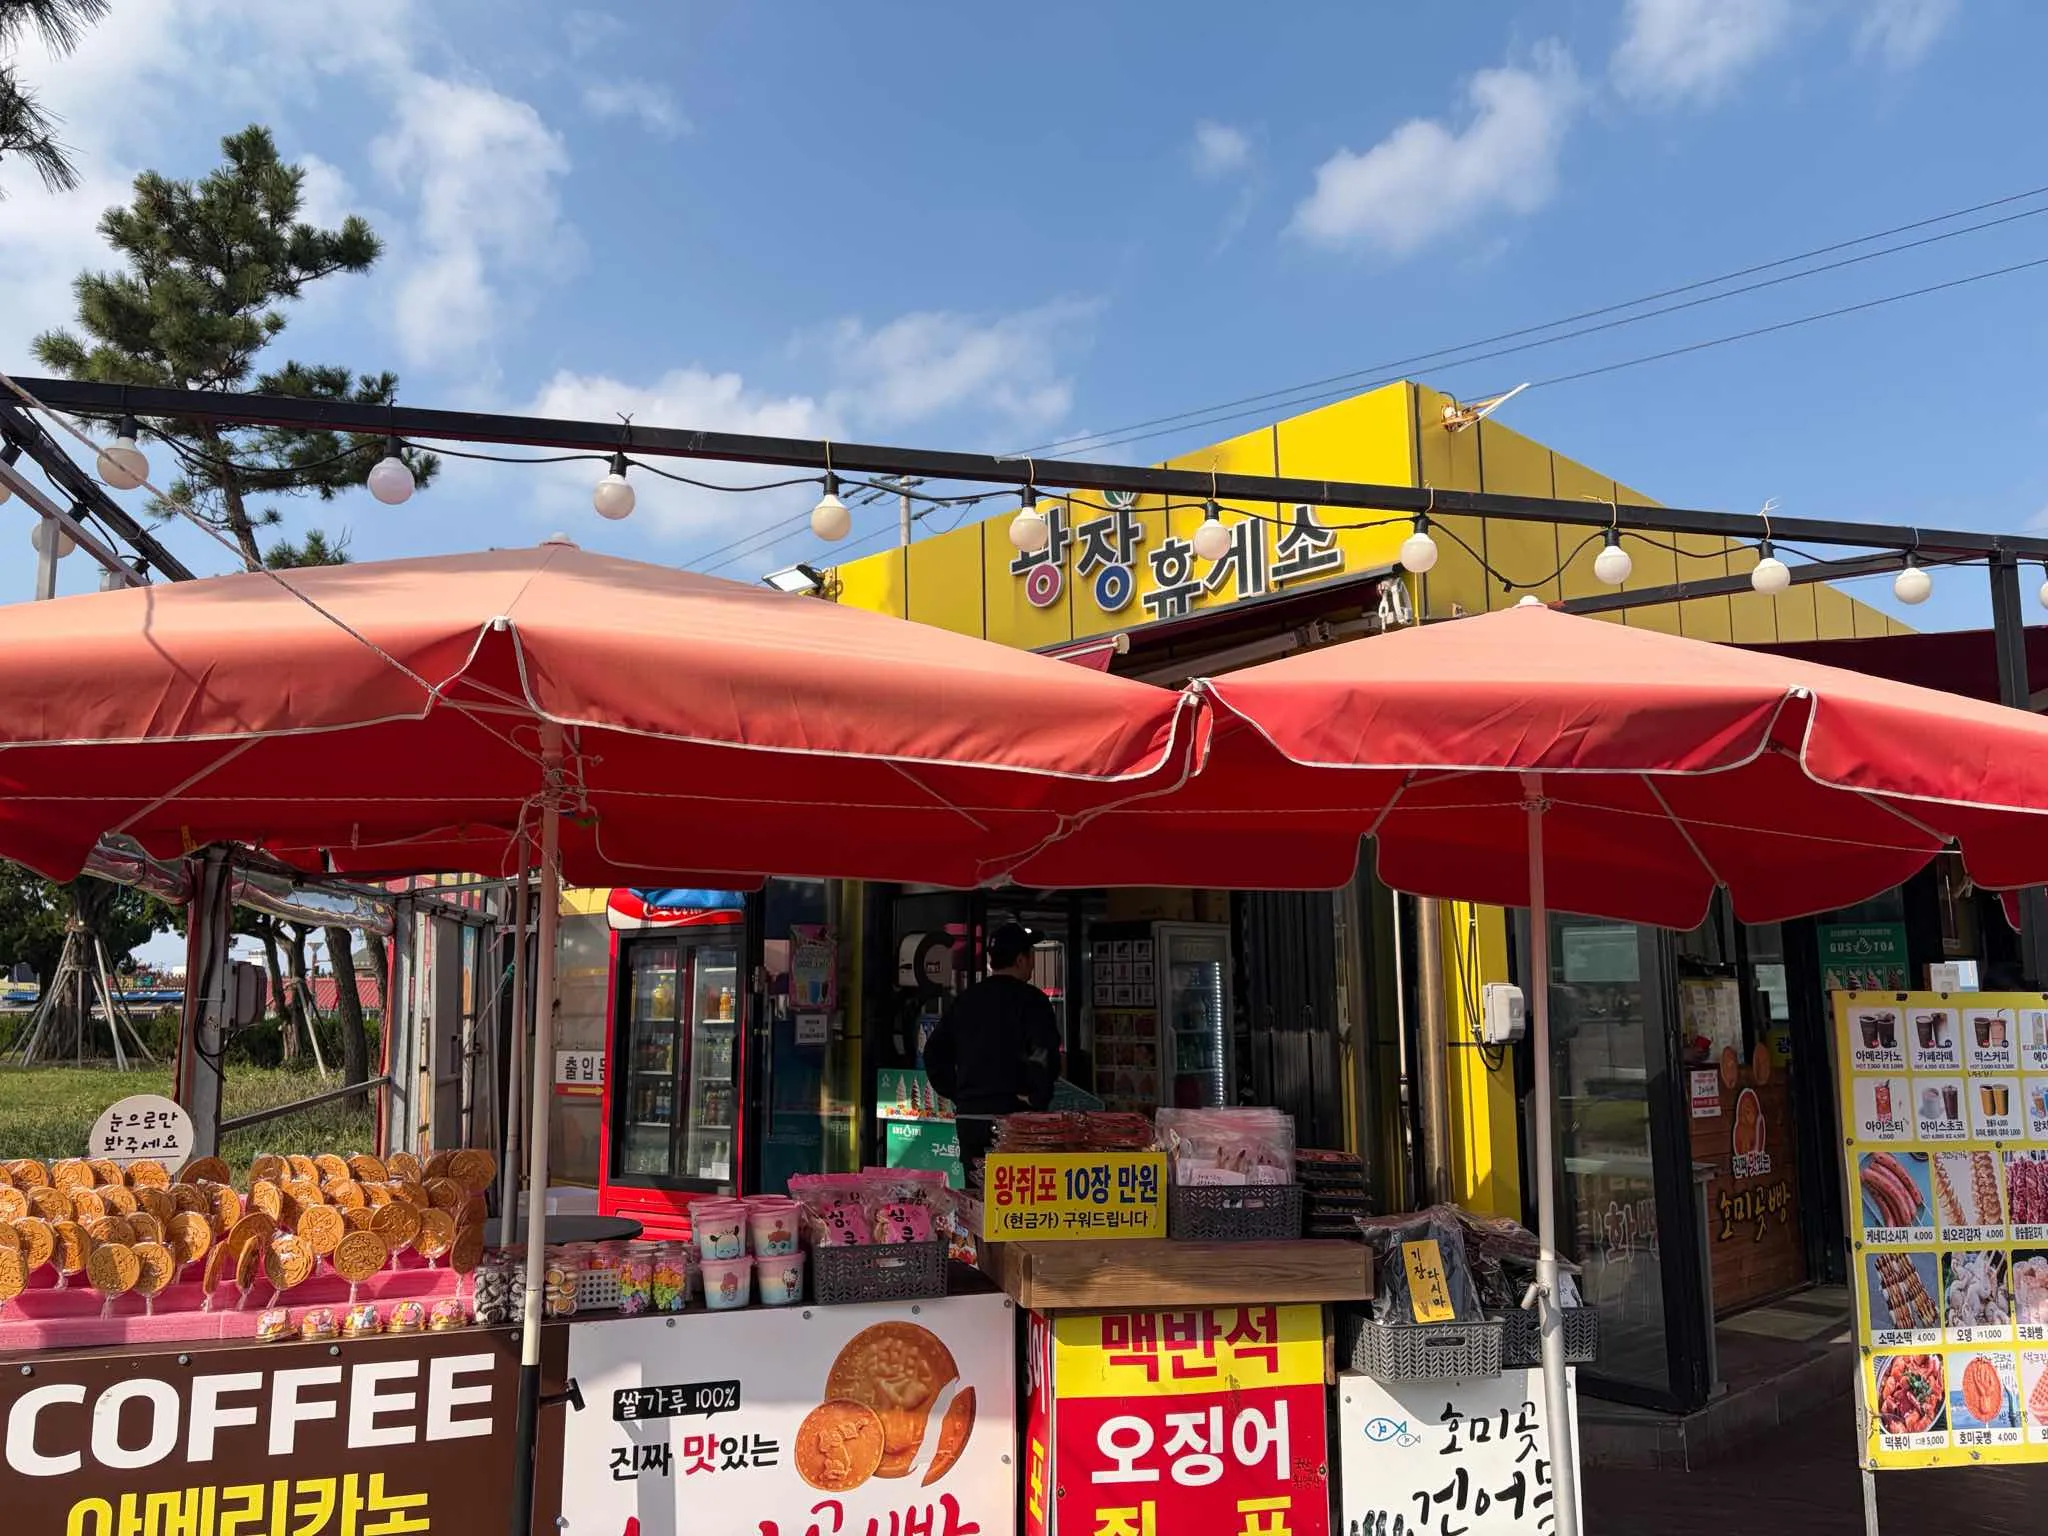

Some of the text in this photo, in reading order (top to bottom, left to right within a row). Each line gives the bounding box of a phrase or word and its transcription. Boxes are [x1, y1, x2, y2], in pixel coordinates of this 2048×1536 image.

[1856, 1050, 1903, 1062] 아메리카노
[1918, 1050, 1953, 1062] 카페라떼
[1975, 1050, 2009, 1062] 믹스커피
[110, 1112, 178, 1132] 눈으로만
[1865, 1121, 1904, 1132] 아이스티
[1920, 1121, 1965, 1132] 아이스초코
[104, 1134, 179, 1153] 봐주세요
[994, 1164, 1158, 1206] 왕쥐포 10장 만원
[1003, 1210, 1149, 1230] (현금가) 구워드립니다
[1866, 1229, 1933, 1243] 케네디소시지 4,000
[1986, 1229, 2004, 1239] 4,000
[1878, 1331, 1936, 1345] 소떡소떡 4,000
[1957, 1328, 1972, 1342] 오뎅
[2018, 1326, 2044, 1340] 국화빵
[1101, 1305, 1279, 1383] 맥반석
[618, 1387, 736, 1419] 쌀가루 100%
[5, 1352, 496, 1477] COFFEE
[1440, 1402, 1540, 1464] 호미곶
[1959, 1430, 2018, 1445] 호미곶빵 4,000
[1091, 1400, 1291, 1487] 오징어
[1885, 1435, 1911, 1450] 떡볶이
[1926, 1435, 1945, 1446] 5,000
[609, 1432, 780, 1480] 진짜 맛있는
[66, 1472, 431, 1536] 아메리카노
